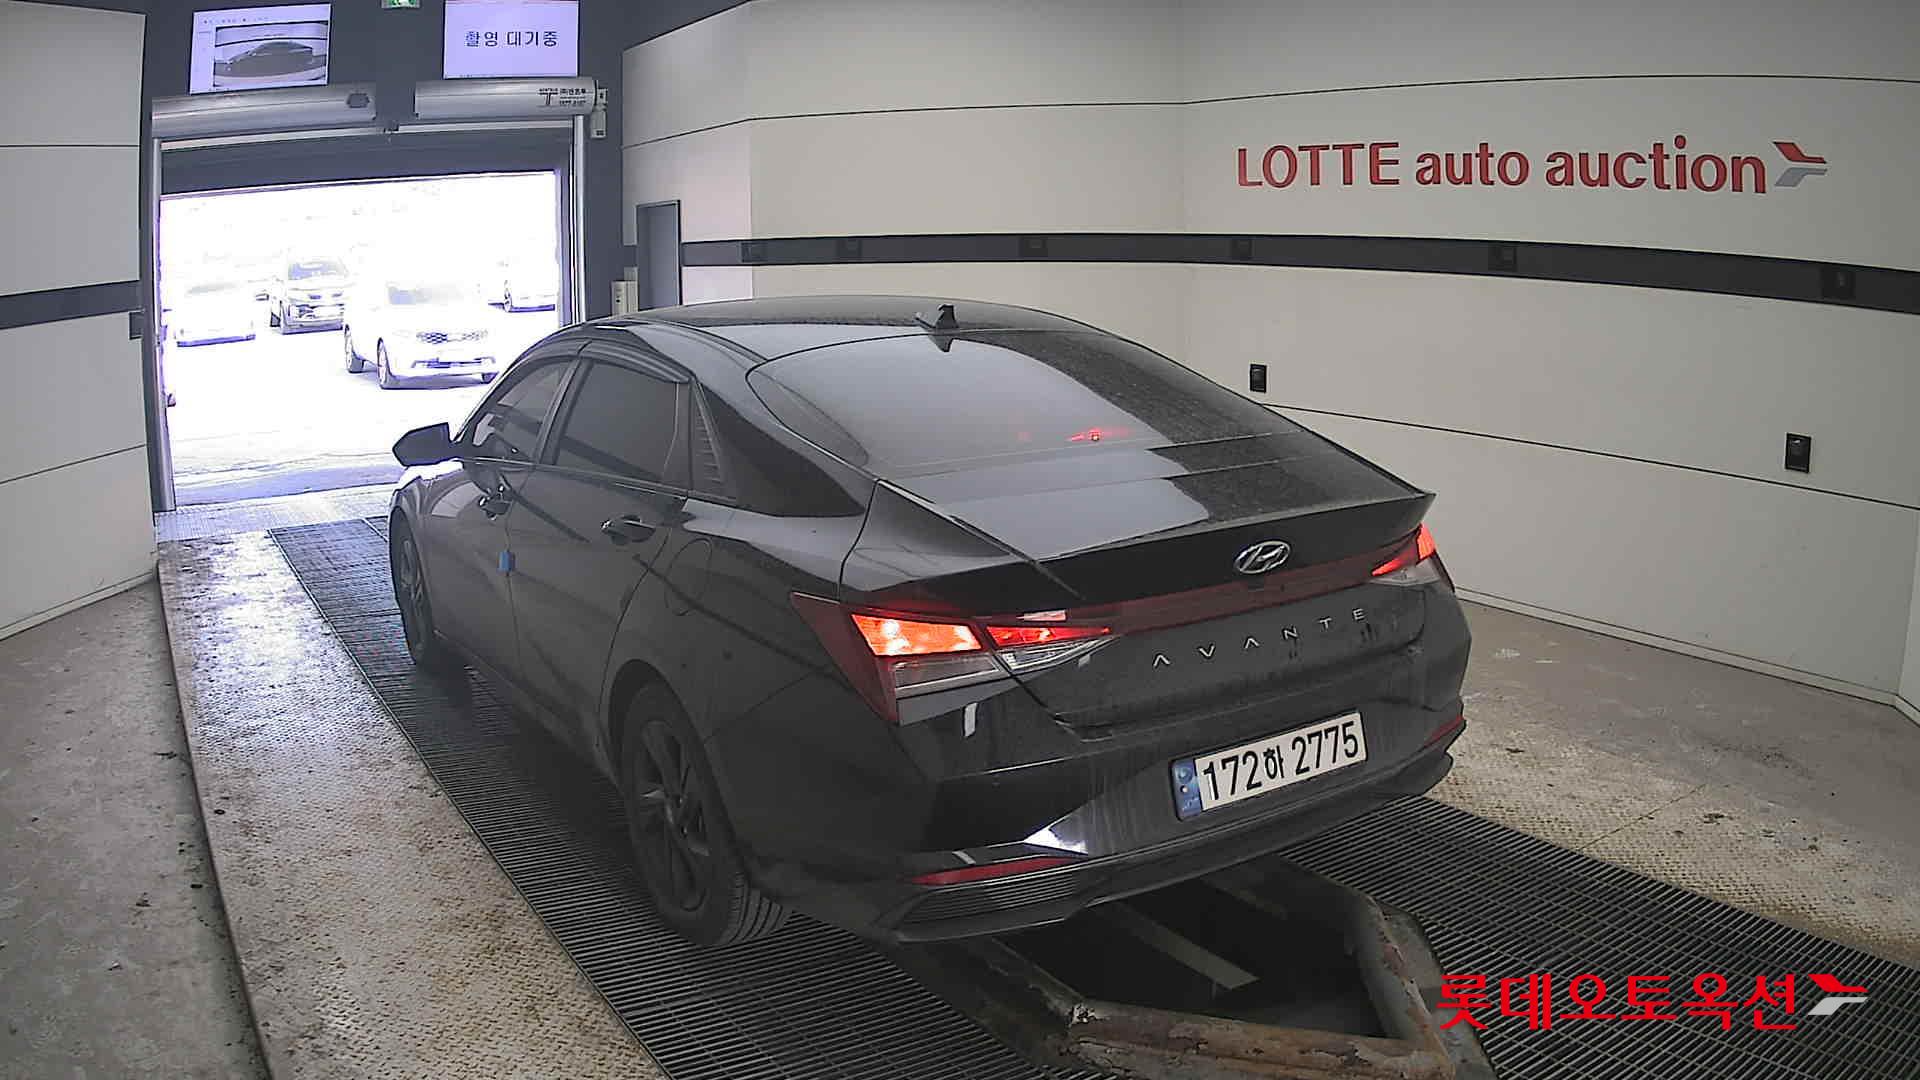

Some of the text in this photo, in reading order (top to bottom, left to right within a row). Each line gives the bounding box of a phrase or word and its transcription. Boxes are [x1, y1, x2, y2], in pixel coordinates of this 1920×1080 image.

[507, 31, 558, 47] 대기중
[1237, 135, 1767, 194] LOTTE auto auction
[1152, 608, 1366, 668] AVANTE
[1202, 721, 1360, 801] 172하 2775
